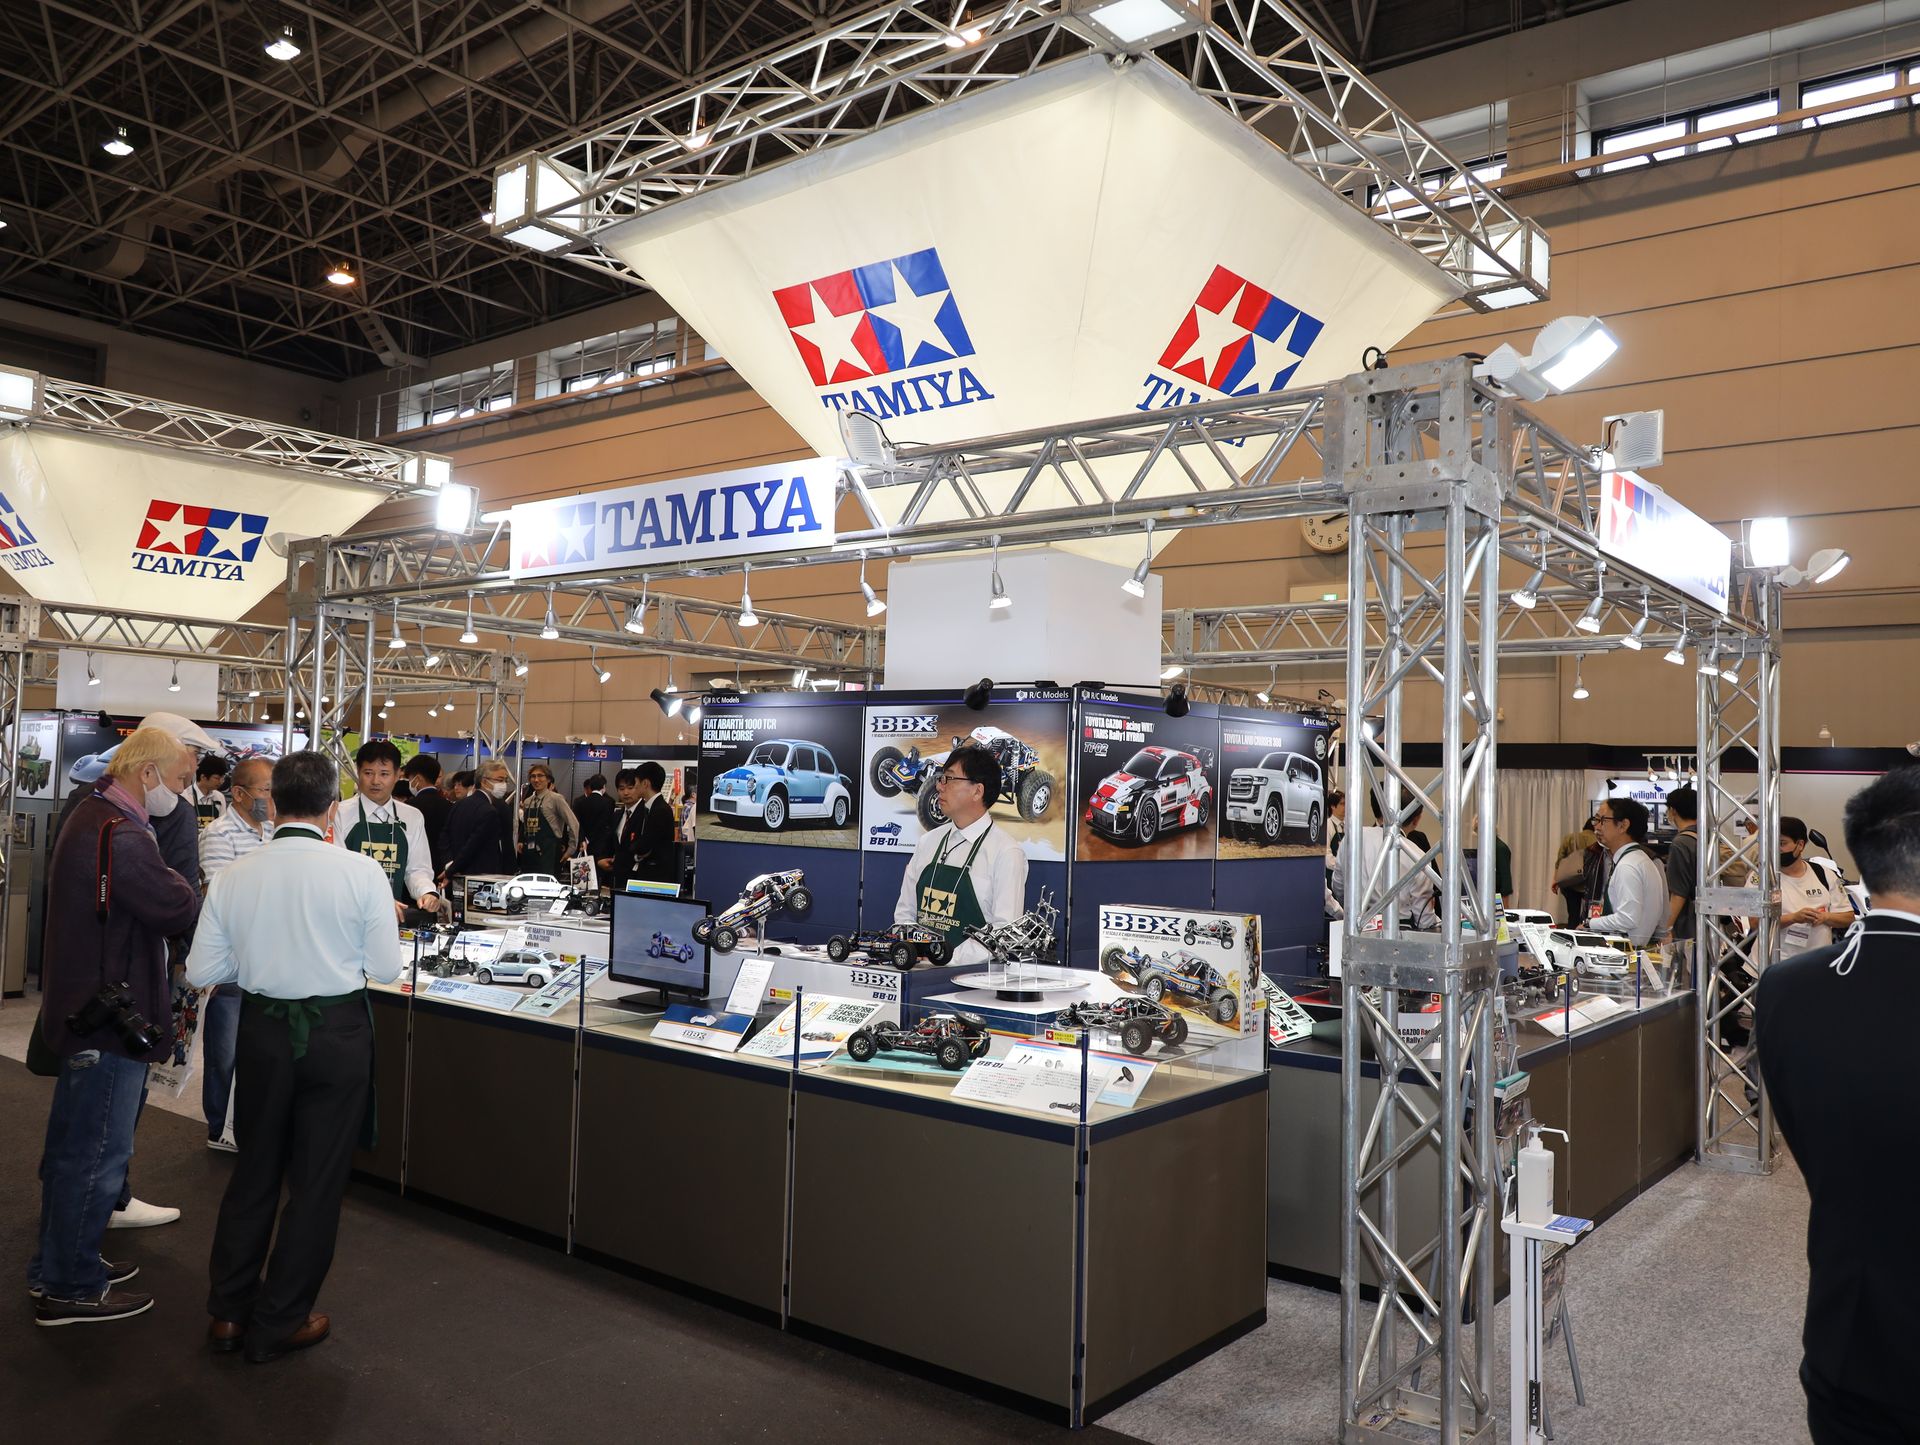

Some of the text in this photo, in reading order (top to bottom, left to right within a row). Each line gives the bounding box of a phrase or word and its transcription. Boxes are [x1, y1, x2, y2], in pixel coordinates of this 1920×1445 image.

[602, 476, 822, 554] TAMIYA
[1, 548, 54, 571] TAMIYA
[131, 551, 245, 582] TAMIYA
[721, 696, 740, 704] Models
[1029, 690, 1069, 699] R/C Models
[1100, 693, 1119, 702] Models
[703, 719, 777, 730] FIAT ABARTH 1000 TCR
[871, 715, 938, 733] BBX
[1084, 716, 1105, 728] TOYOTA
[702, 730, 753, 741] BERLINA CORSE
[1629, 791, 1657, 800] twilight
[934, 922, 951, 932] SIDE
[1101, 911, 1182, 936] BBX
[913, 931, 923, 942] 45
[849, 970, 898, 989] BBX
[1402, 1028, 1420, 1036] GAZOO
